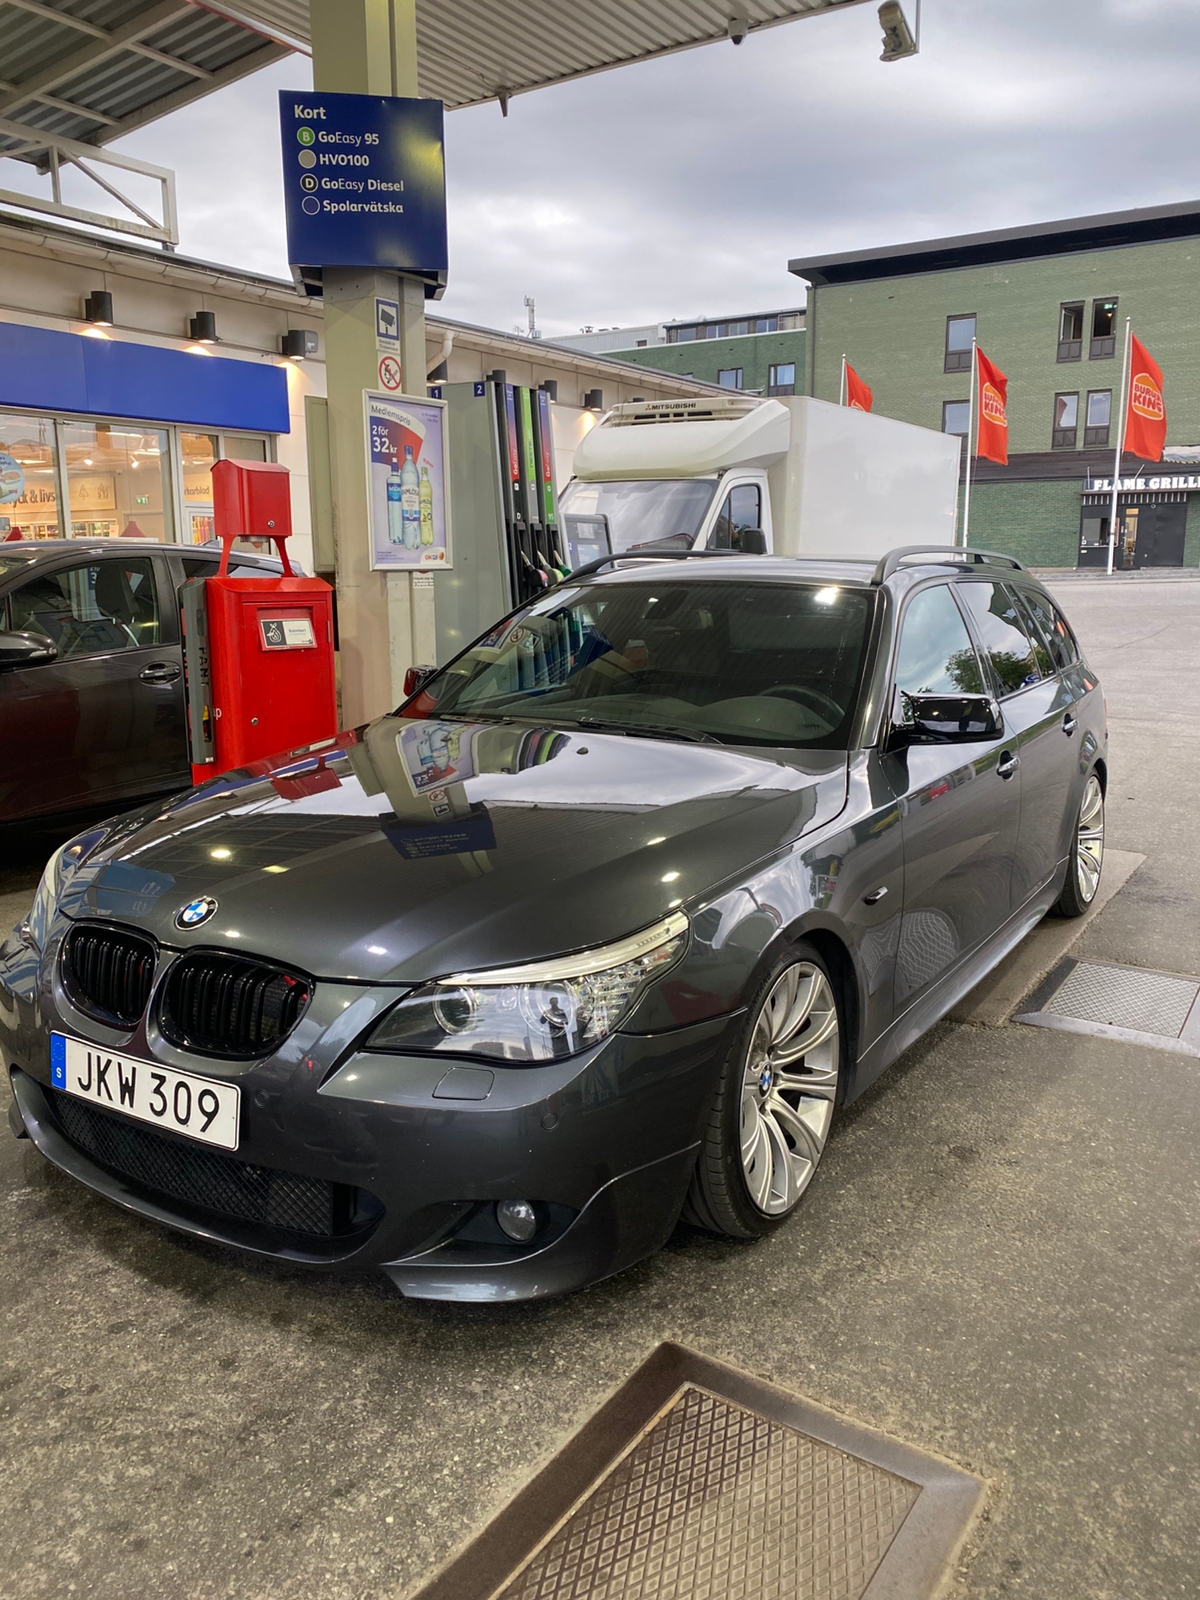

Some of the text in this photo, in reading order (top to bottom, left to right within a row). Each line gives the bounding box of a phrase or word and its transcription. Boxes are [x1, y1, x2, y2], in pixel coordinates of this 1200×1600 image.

[294, 105, 326, 119] Kort
[302, 131, 379, 146] B GoEasy 95
[319, 154, 370, 166] HVO100
[305, 177, 404, 193] D GoEasy Diesel
[323, 200, 404, 214] Spolarvätska
[434, 389, 439, 398] 1
[477, 385, 482, 394] 2
[1133, 392, 1162, 413] KING
[371, 405, 411, 426] Medlemspris
[372, 425, 389, 436] 2 för
[373, 437, 397, 453] 32 kr
[1094, 475, 1200, 491] FLAME GRILL
[56, 1067, 62, 1078] S
[78, 1052, 219, 1132] JKW 309
